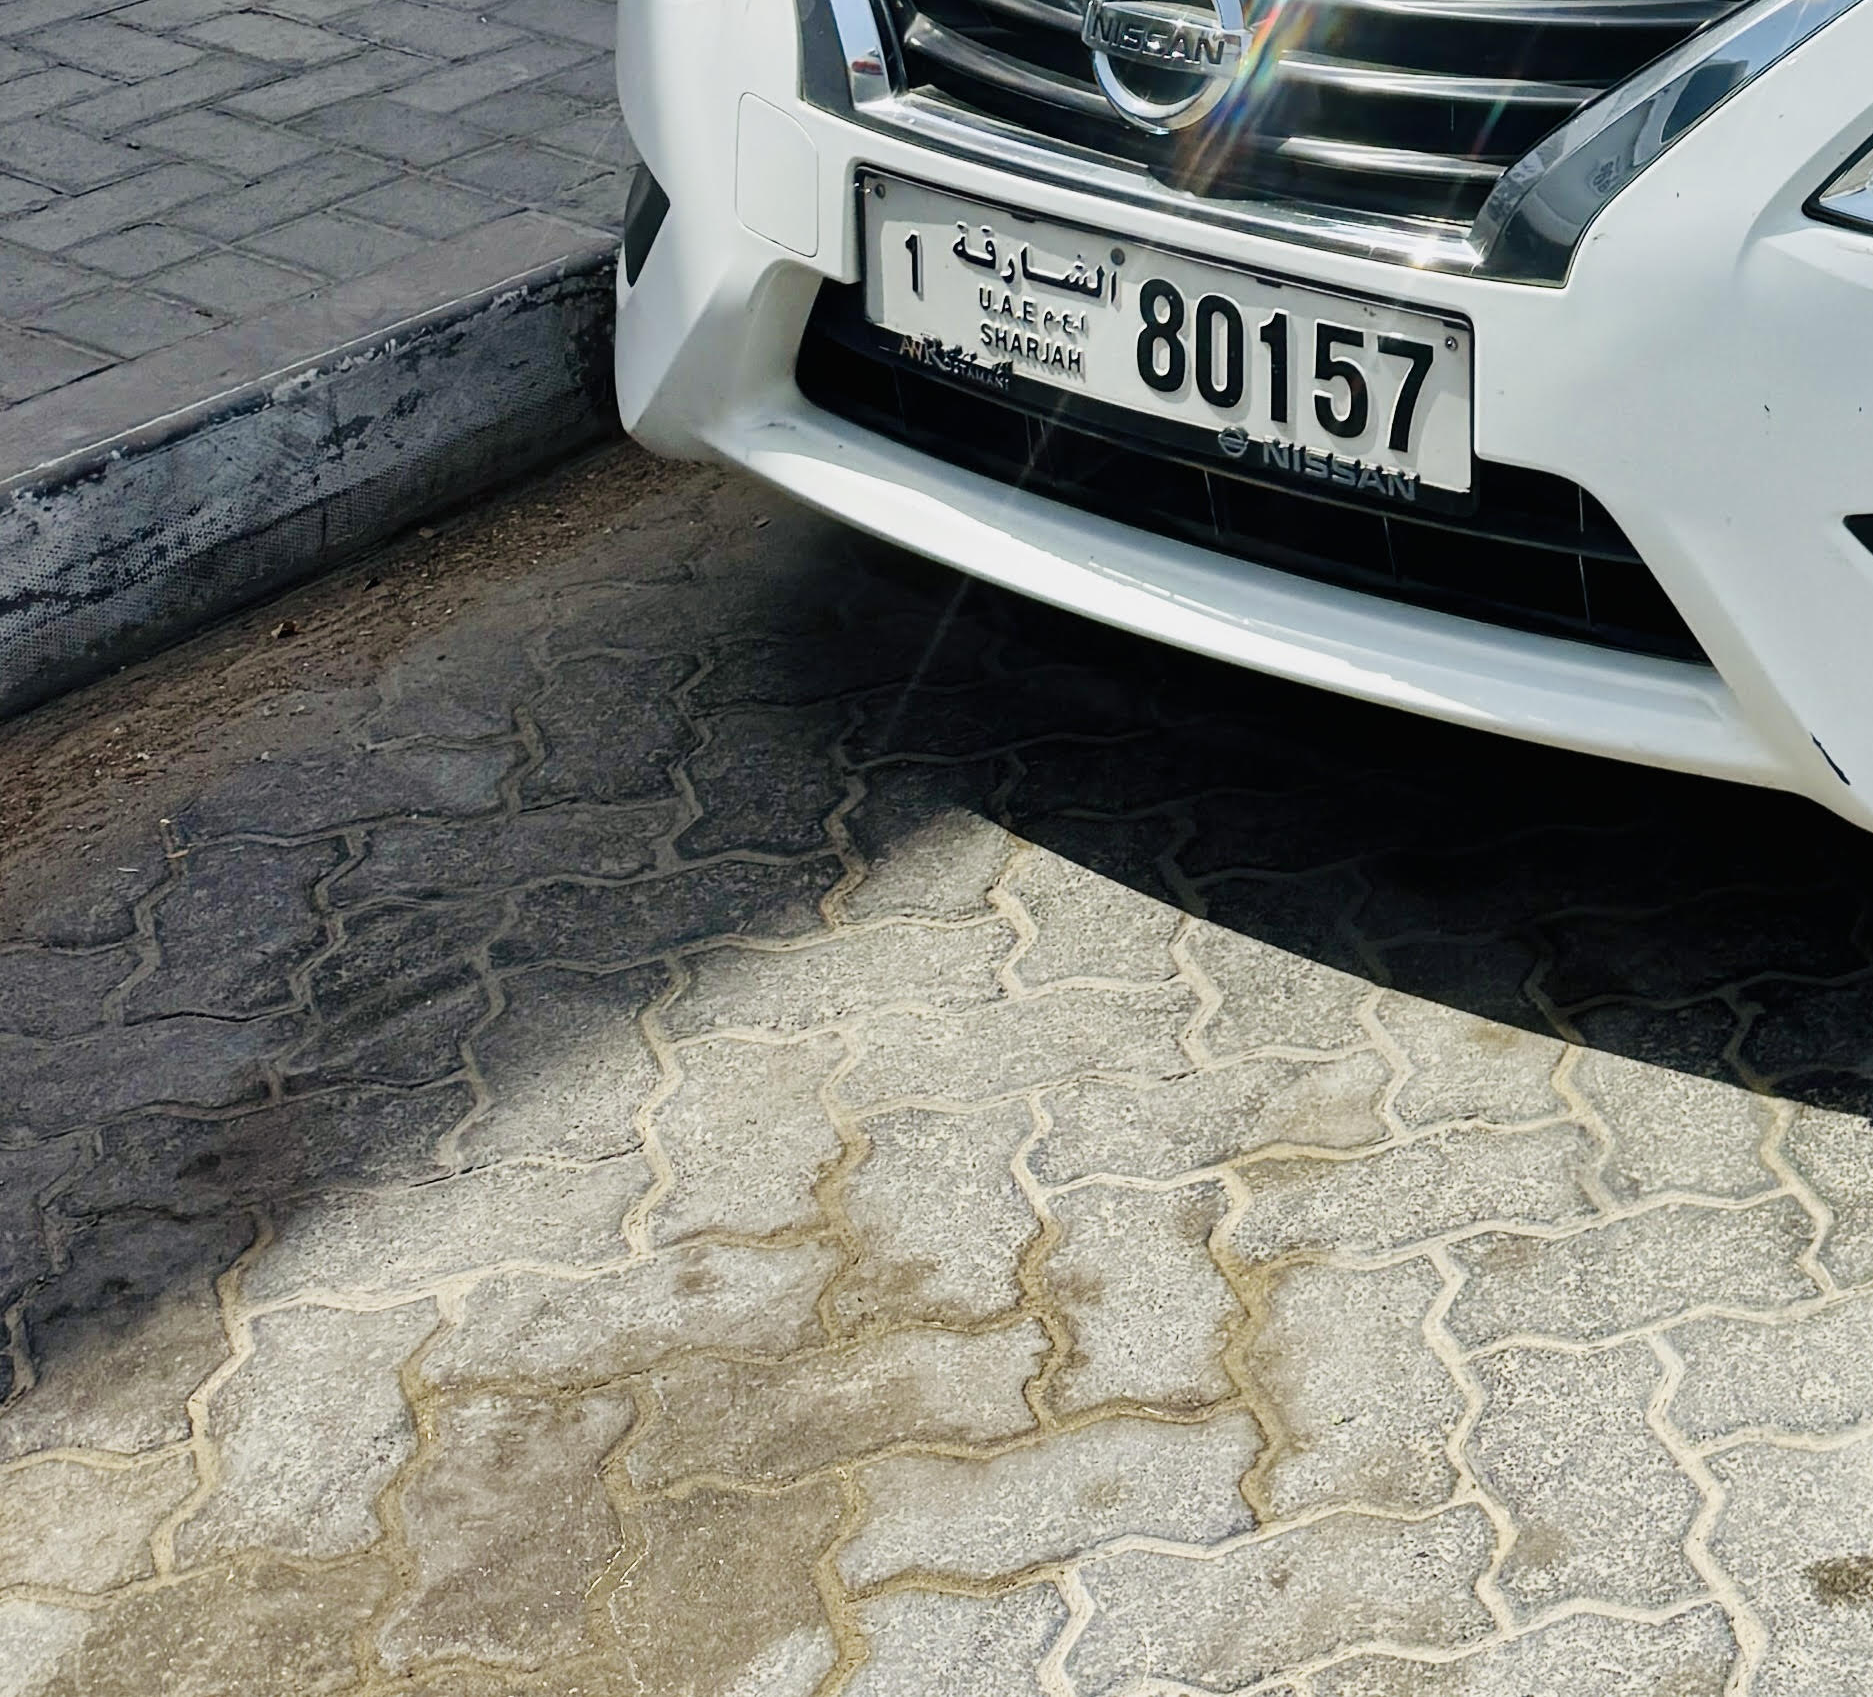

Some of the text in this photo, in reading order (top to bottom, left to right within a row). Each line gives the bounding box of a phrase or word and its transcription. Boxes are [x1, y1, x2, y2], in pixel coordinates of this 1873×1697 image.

[1090, 8, 1226, 66] NISSAN
[904, 231, 921, 295] 1
[952, 221, 1118, 304] الشارقة
[979, 321, 1082, 373] SHARJAH
[1136, 277, 1435, 454] 80157
[1262, 441, 1418, 502] NISSAN
